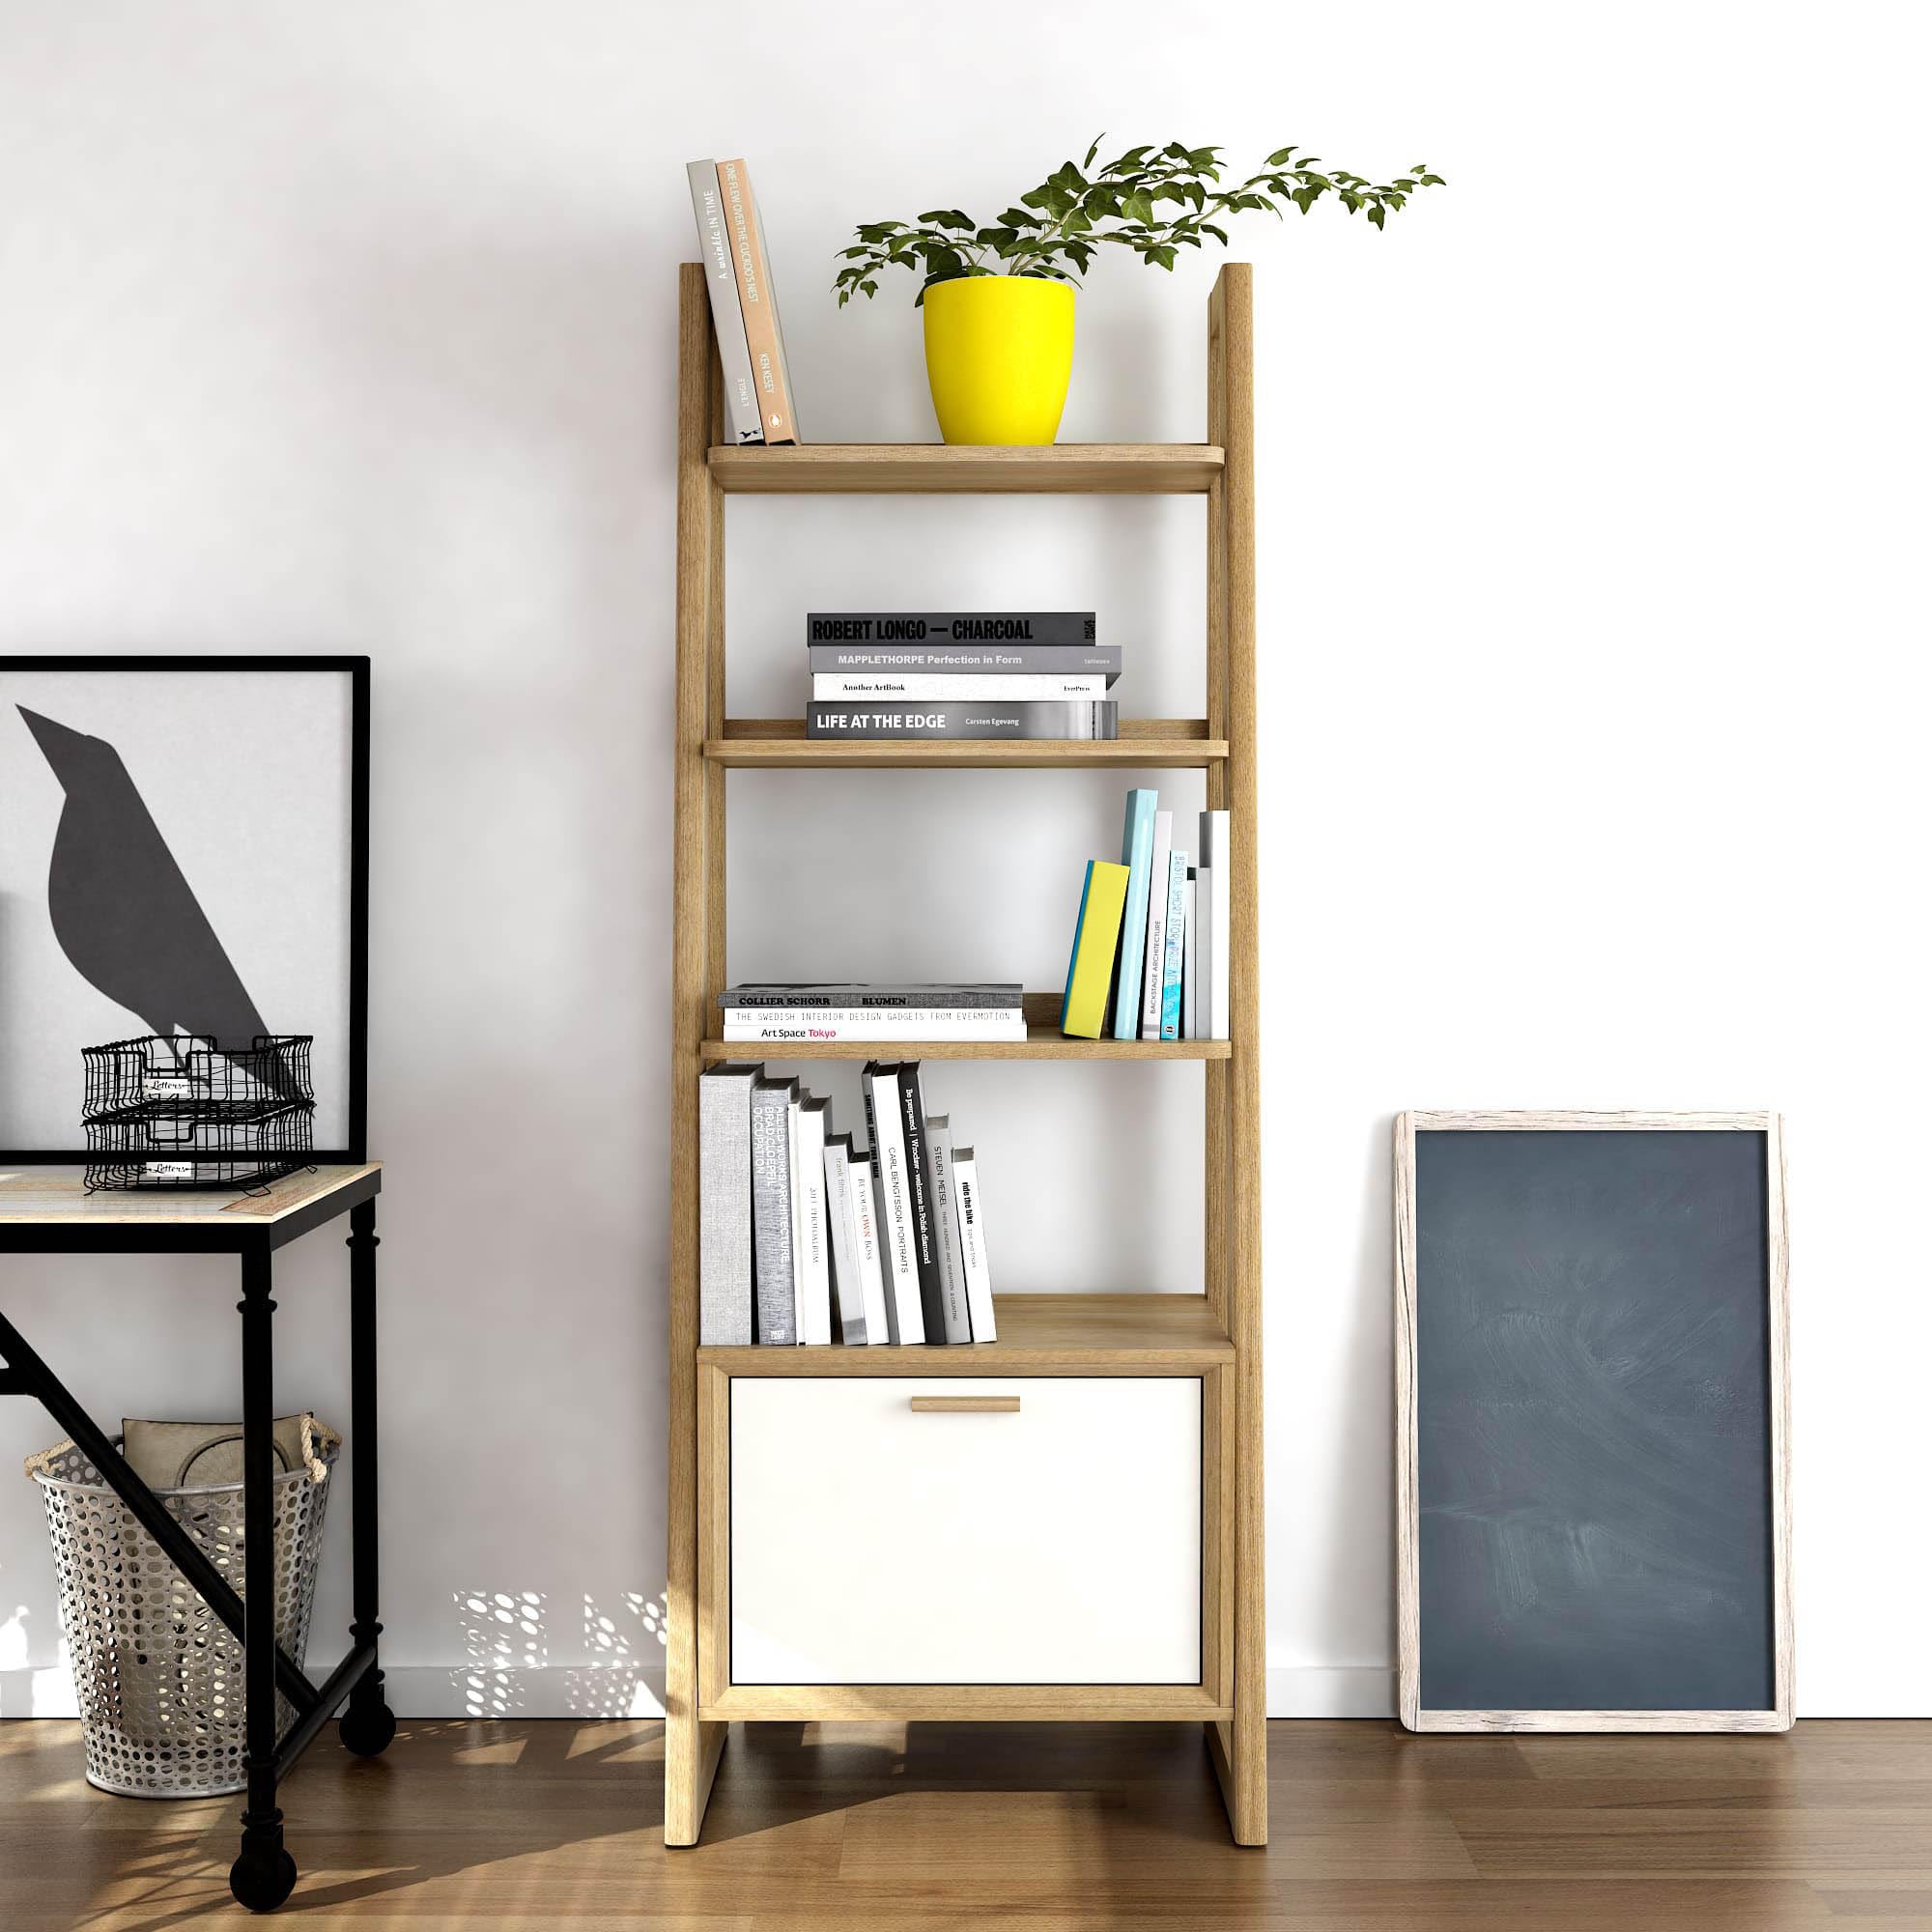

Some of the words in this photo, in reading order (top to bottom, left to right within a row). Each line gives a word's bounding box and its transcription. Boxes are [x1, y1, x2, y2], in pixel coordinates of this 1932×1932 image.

[725, 163, 737, 182] ONE
[702, 189, 714, 215] TIME
[729, 182, 742, 203] FLEW
[709, 216, 719, 230] IN
[732, 204, 744, 225] OVER
[736, 226, 748, 242] THE
[712, 230, 726, 270] wrinkle
[739, 242, 753, 283] CUCKOO'S
[747, 283, 758, 303] NEST
[759, 353, 770, 371] KEN
[762, 371, 776, 393] KESEY
[812, 620, 872, 640] ROBERT
[876, 620, 926, 640] LONGO
[952, 620, 1034, 640] CHARCOAL
[838, 655, 924, 665] MAPPLETHORPE
[926, 654, 980, 665] Perfection
[982, 654, 993, 665] in
[995, 654, 1022, 665] Form
[816, 714, 848, 728] LIFE
[850, 714, 870, 728] AT
[872, 714, 902, 728] THE
[905, 714, 946, 728] EDGE
[965, 718, 991, 726] Carsten
[991, 718, 1019, 727] Egevang
[1172, 890, 1182, 915] SHORT
[1152, 920, 1162, 972] ARCHITECTURE
[739, 997, 784, 1006] COLLIER
[786, 997, 831, 1006] SCHORR
[862, 997, 907, 1006] BLUMEN
[1150, 973, 1159, 1014] BACKSTAGE
[735, 1012, 753, 1021] THE
[757, 1012, 795, 1021] SWEDISH
[801, 1012, 844, 1021] INTERIOR
[849, 1012, 882, 1021] DESIGN
[887, 1012, 924, 1021] GADGETS
[929, 1012, 952, 1021] FROM
[956, 1012, 1010, 1021] EVERMOTION
[761, 1028, 777, 1037] Art
[779, 1028, 806, 1039] Space
[808, 1028, 837, 1039] Tokyo
[765, 1107, 775, 1135] BRAD
[776, 1107, 786, 1142] ALLIED
[753, 1107, 765, 1174] OCCUPATION
[777, 1145, 787, 1181] WORKS
[836, 1157, 844, 1178] frank
[888, 1148, 897, 1170] CARL
[933, 1147, 944, 1176] STEVEN
[906, 1089, 914, 1098] Be
[914, 1173, 923, 1205] welcome
[922, 1234, 931, 1264] diamond
[891, 1171, 903, 1223] BENGTSSON
[938, 1179, 947, 1208] MEISEL
[961, 1181, 971, 1196] ride
[963, 1197, 972, 1208] the
[779, 1183, 790, 1264] ARCHITECTURE
[965, 1209, 974, 1225] bike
[896, 1226, 909, 1273] PORTRAITS
